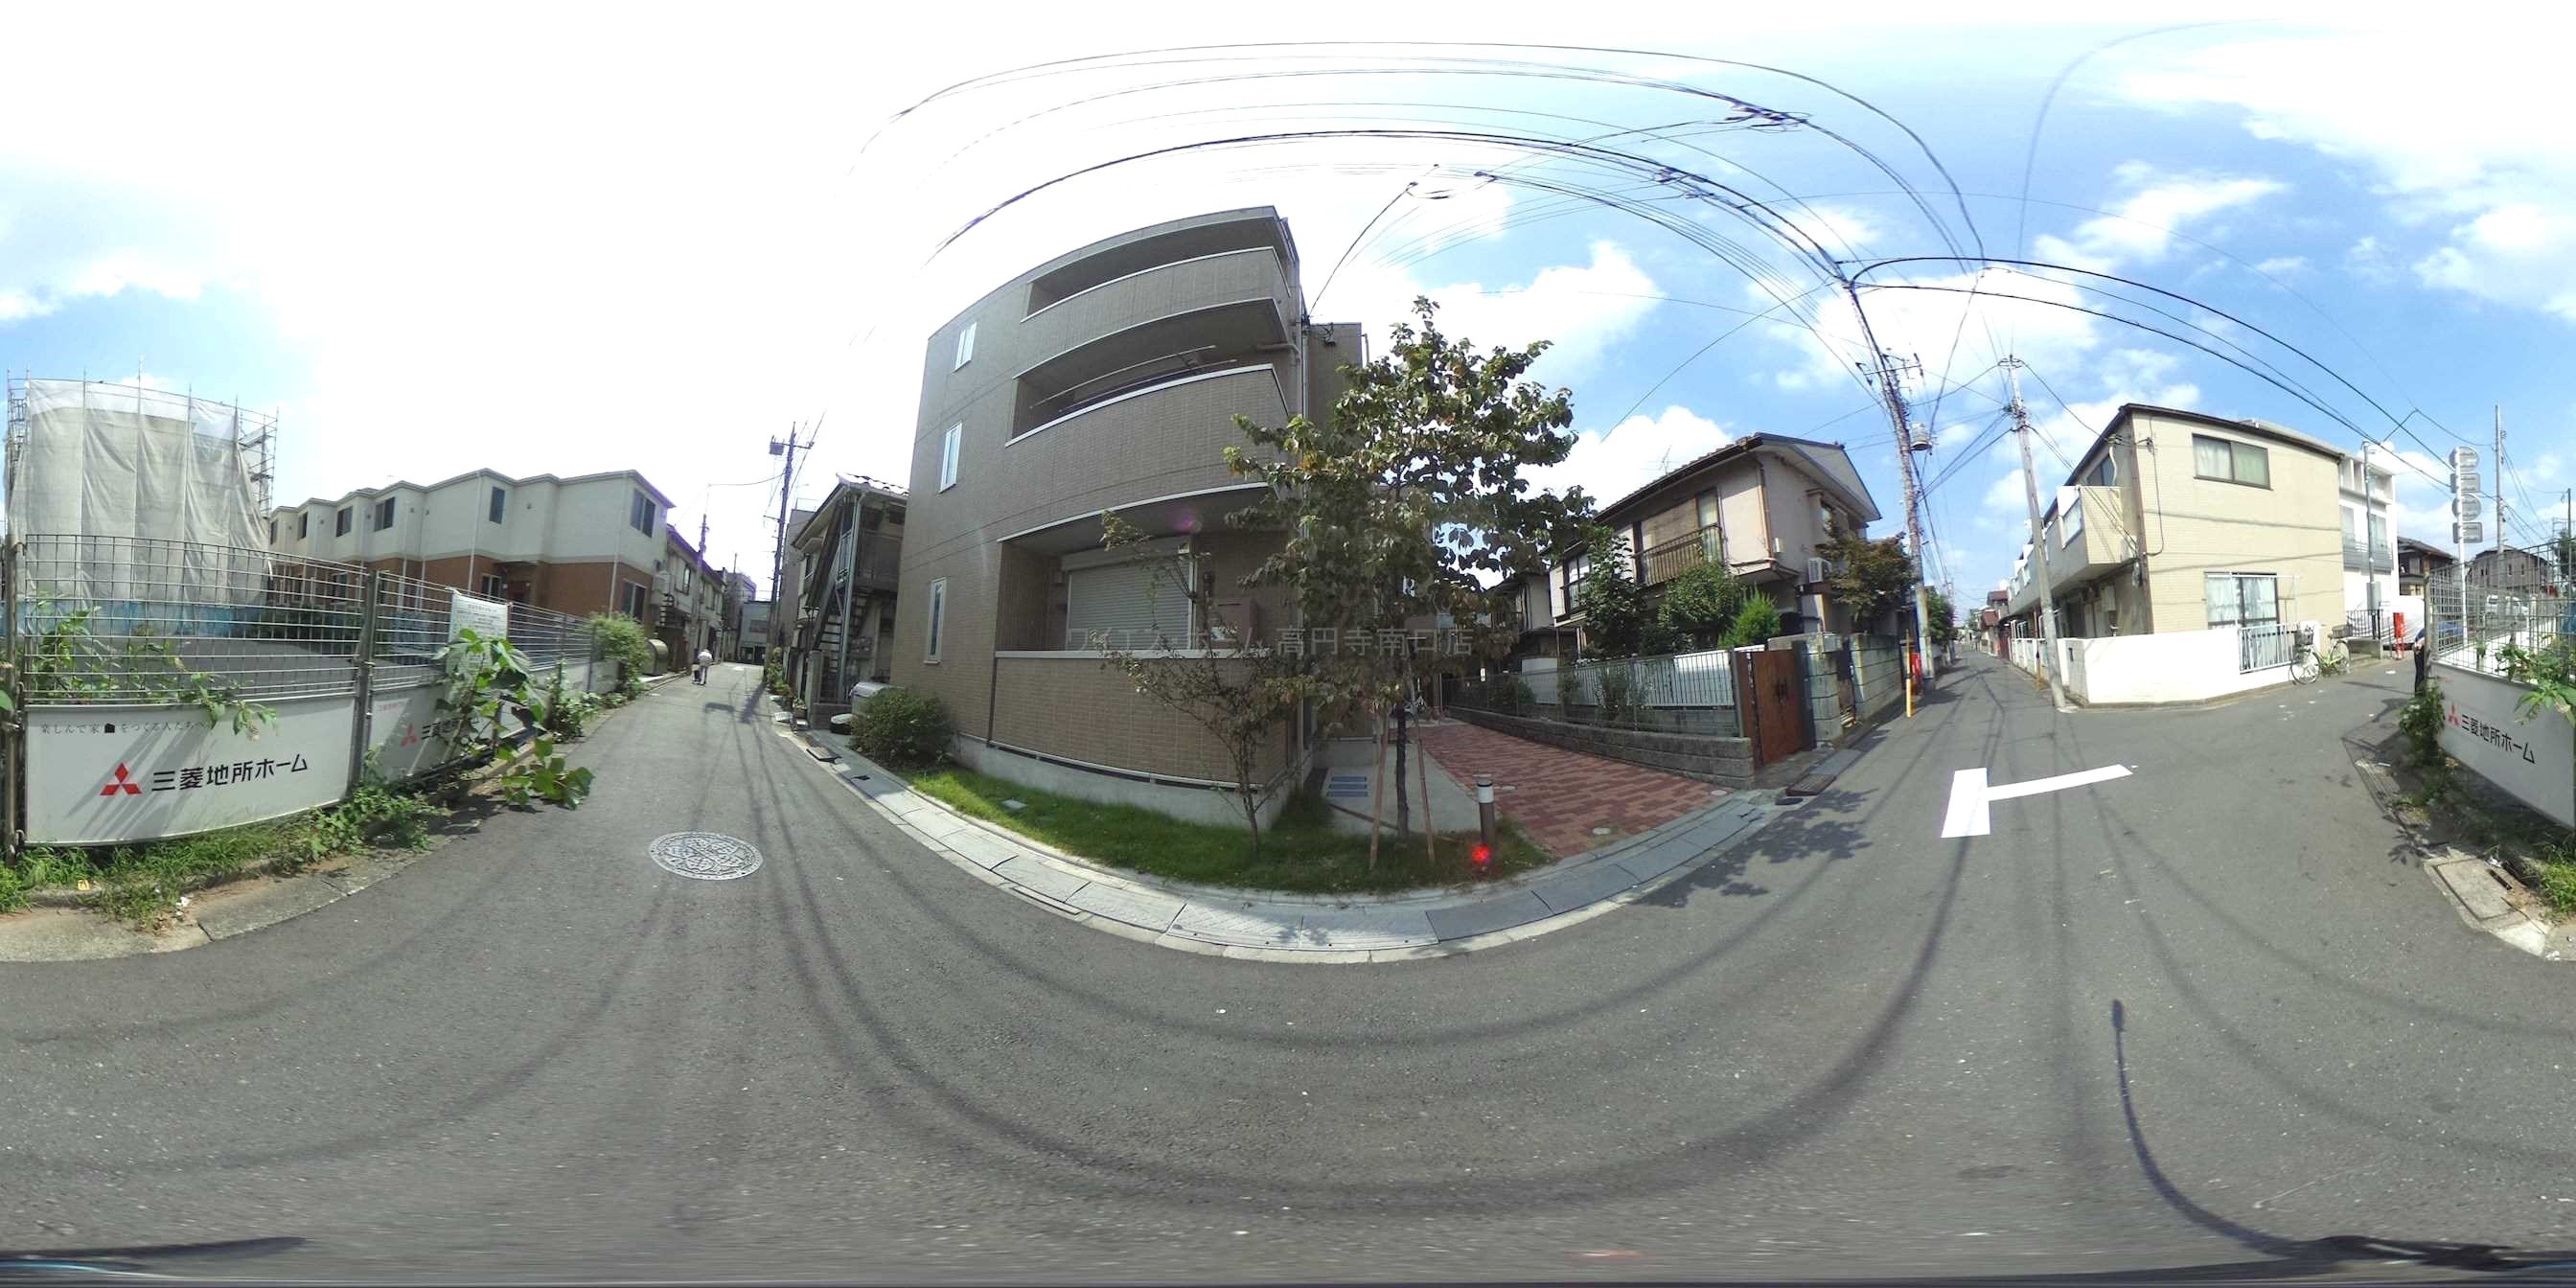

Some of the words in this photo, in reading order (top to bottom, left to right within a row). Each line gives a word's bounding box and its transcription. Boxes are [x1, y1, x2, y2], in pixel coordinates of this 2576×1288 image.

[2461, 714, 2536, 764] 三菱地所ホーム
[151, 753, 309, 793] 三菱地所ホーム
